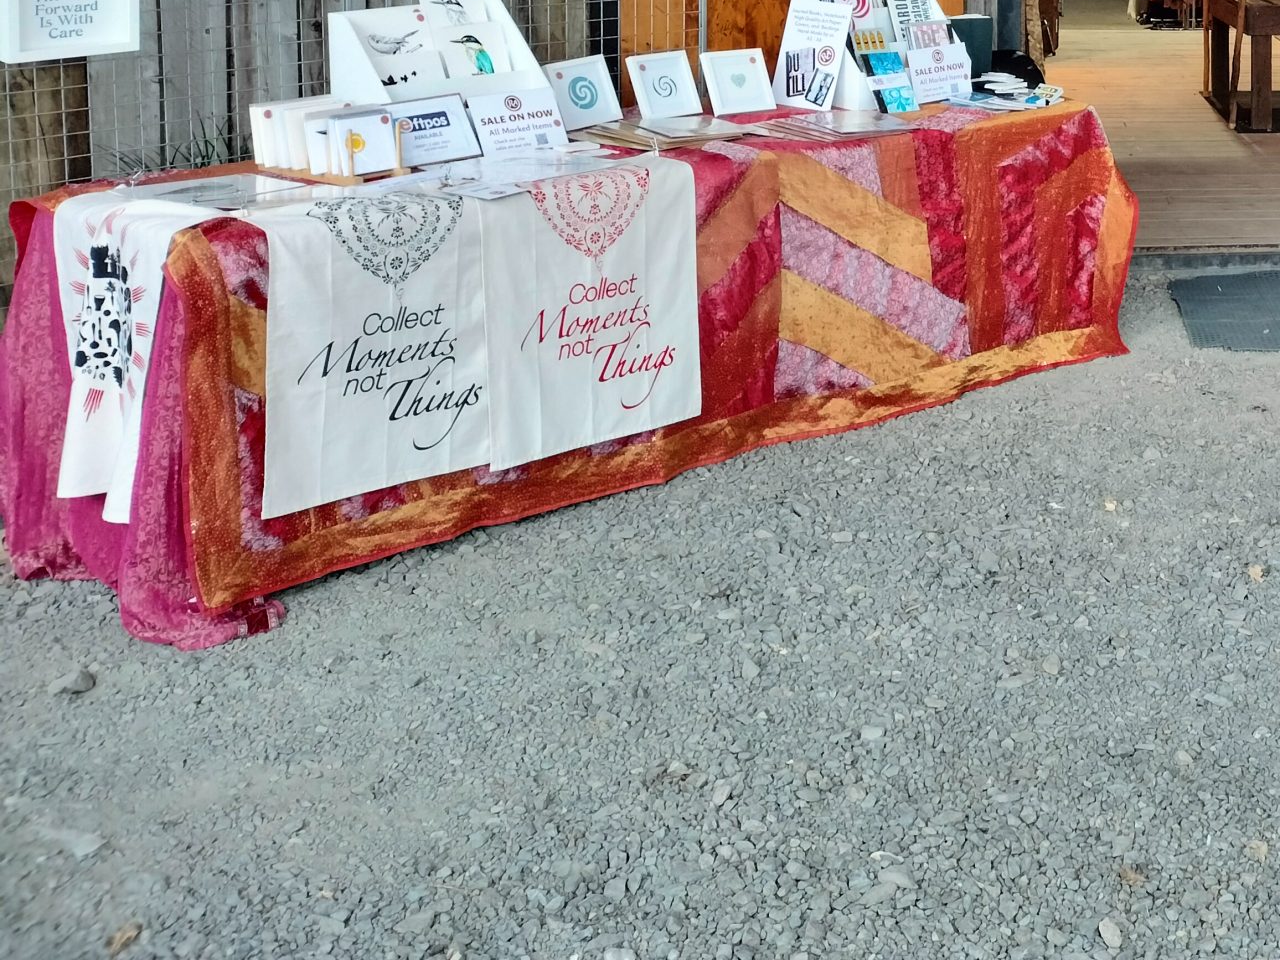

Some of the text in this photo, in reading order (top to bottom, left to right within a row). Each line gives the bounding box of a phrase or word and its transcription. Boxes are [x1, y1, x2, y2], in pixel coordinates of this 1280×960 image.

[34, 0, 98, 16] Forward
[39, 14, 93, 28] Is With
[48, 27, 84, 39] Care
[914, 62, 965, 76] SALE ON NOW
[400, 116, 448, 131] eftpos
[480, 109, 553, 126] SALE ON NOW
[502, 124, 531, 134] Marked
[568, 273, 637, 305] Collect
[363, 303, 445, 336] Collect
[520, 296, 651, 352] Moments
[297, 328, 457, 386] Moments
[558, 321, 676, 410] not Things
[343, 356, 483, 451] not Things
